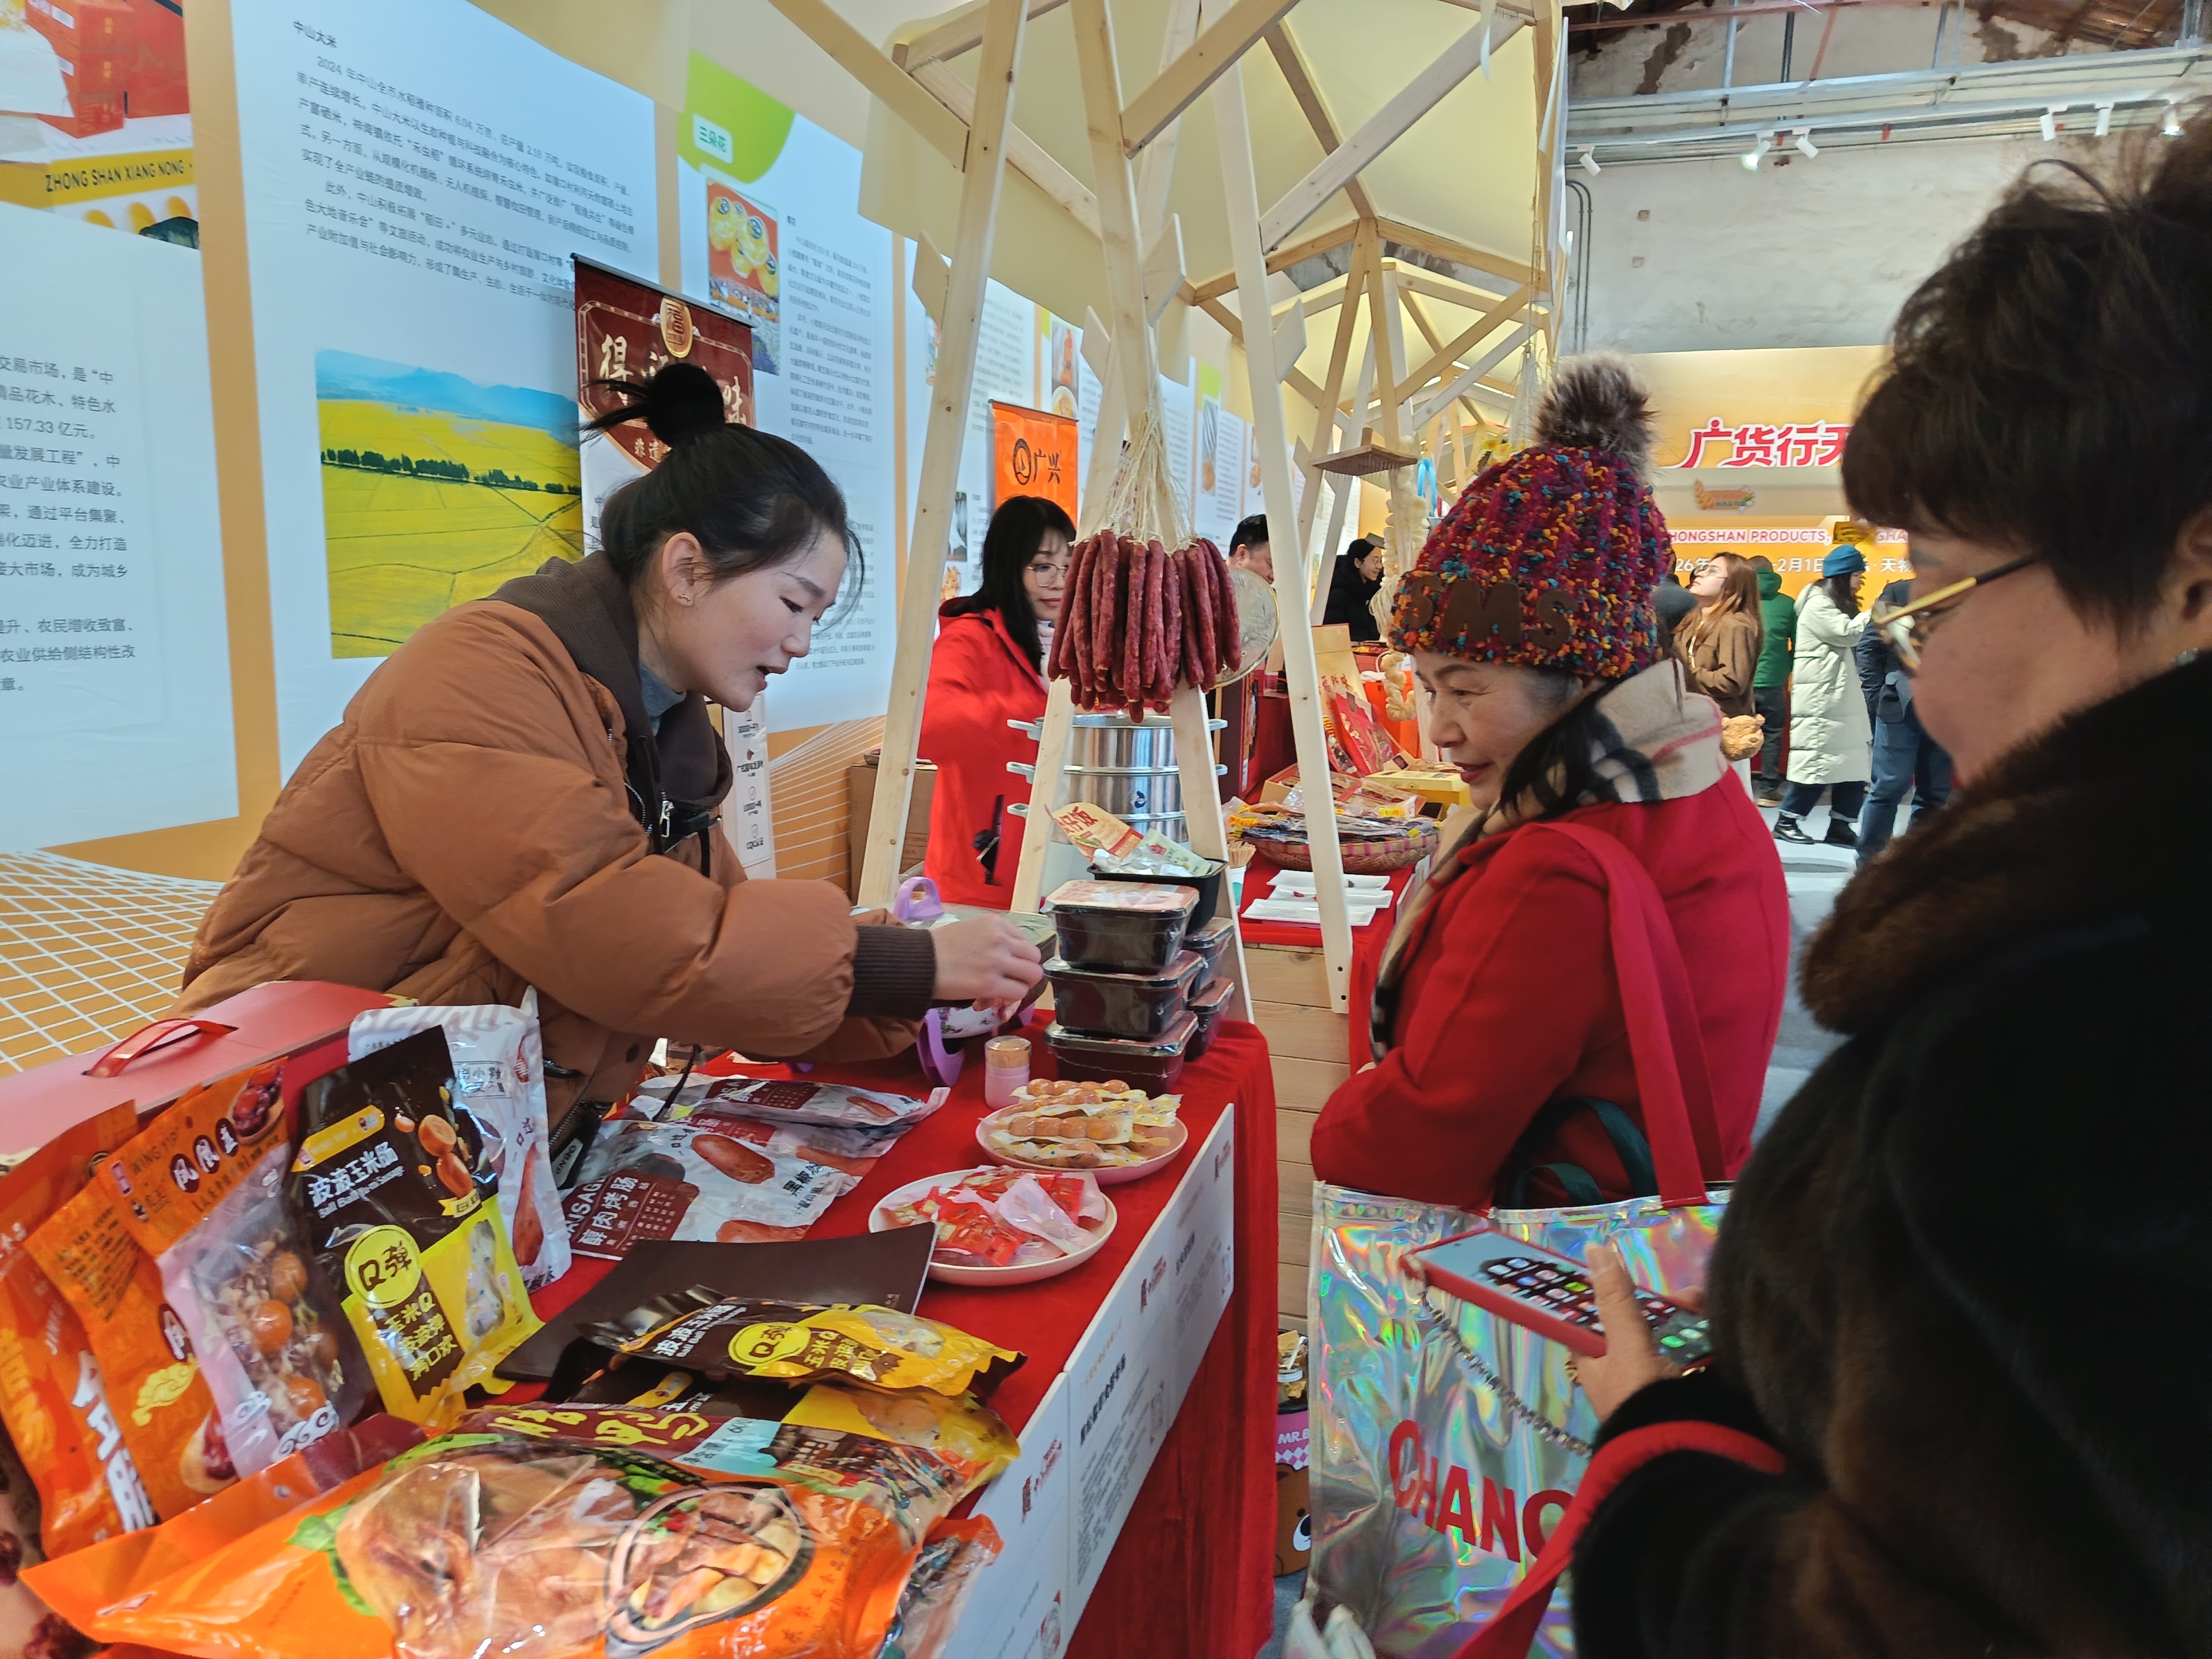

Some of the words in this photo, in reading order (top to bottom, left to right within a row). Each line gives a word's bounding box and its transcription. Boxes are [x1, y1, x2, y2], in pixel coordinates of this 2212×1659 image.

[293, 21, 337, 49] 中山大米
[316, 54, 342, 76] 2024
[699, 126, 728, 153] 三朵花
[45, 170, 88, 192] ZHONG
[91, 168, 122, 186] SHAN
[124, 163, 156, 182] XIANG
[158, 160, 185, 176] NONG
[6, 416, 54, 434] 157.33
[58, 421, 96, 439] 亿元。
[1033, 447, 1061, 484] 广兴
[0, 532, 128, 552] 化迈进，全力打造
[1751, 530, 1830, 544] PRODUCTS,
[0, 617, 133, 634] 升、农民增收致富、
[564, 1177, 607, 1233] AUSAG
[577, 1177, 639, 1246] 醇肉烤肠
[358, 1240, 412, 1292] Q弹
[384, 1292, 436, 1333] 玉米Q
